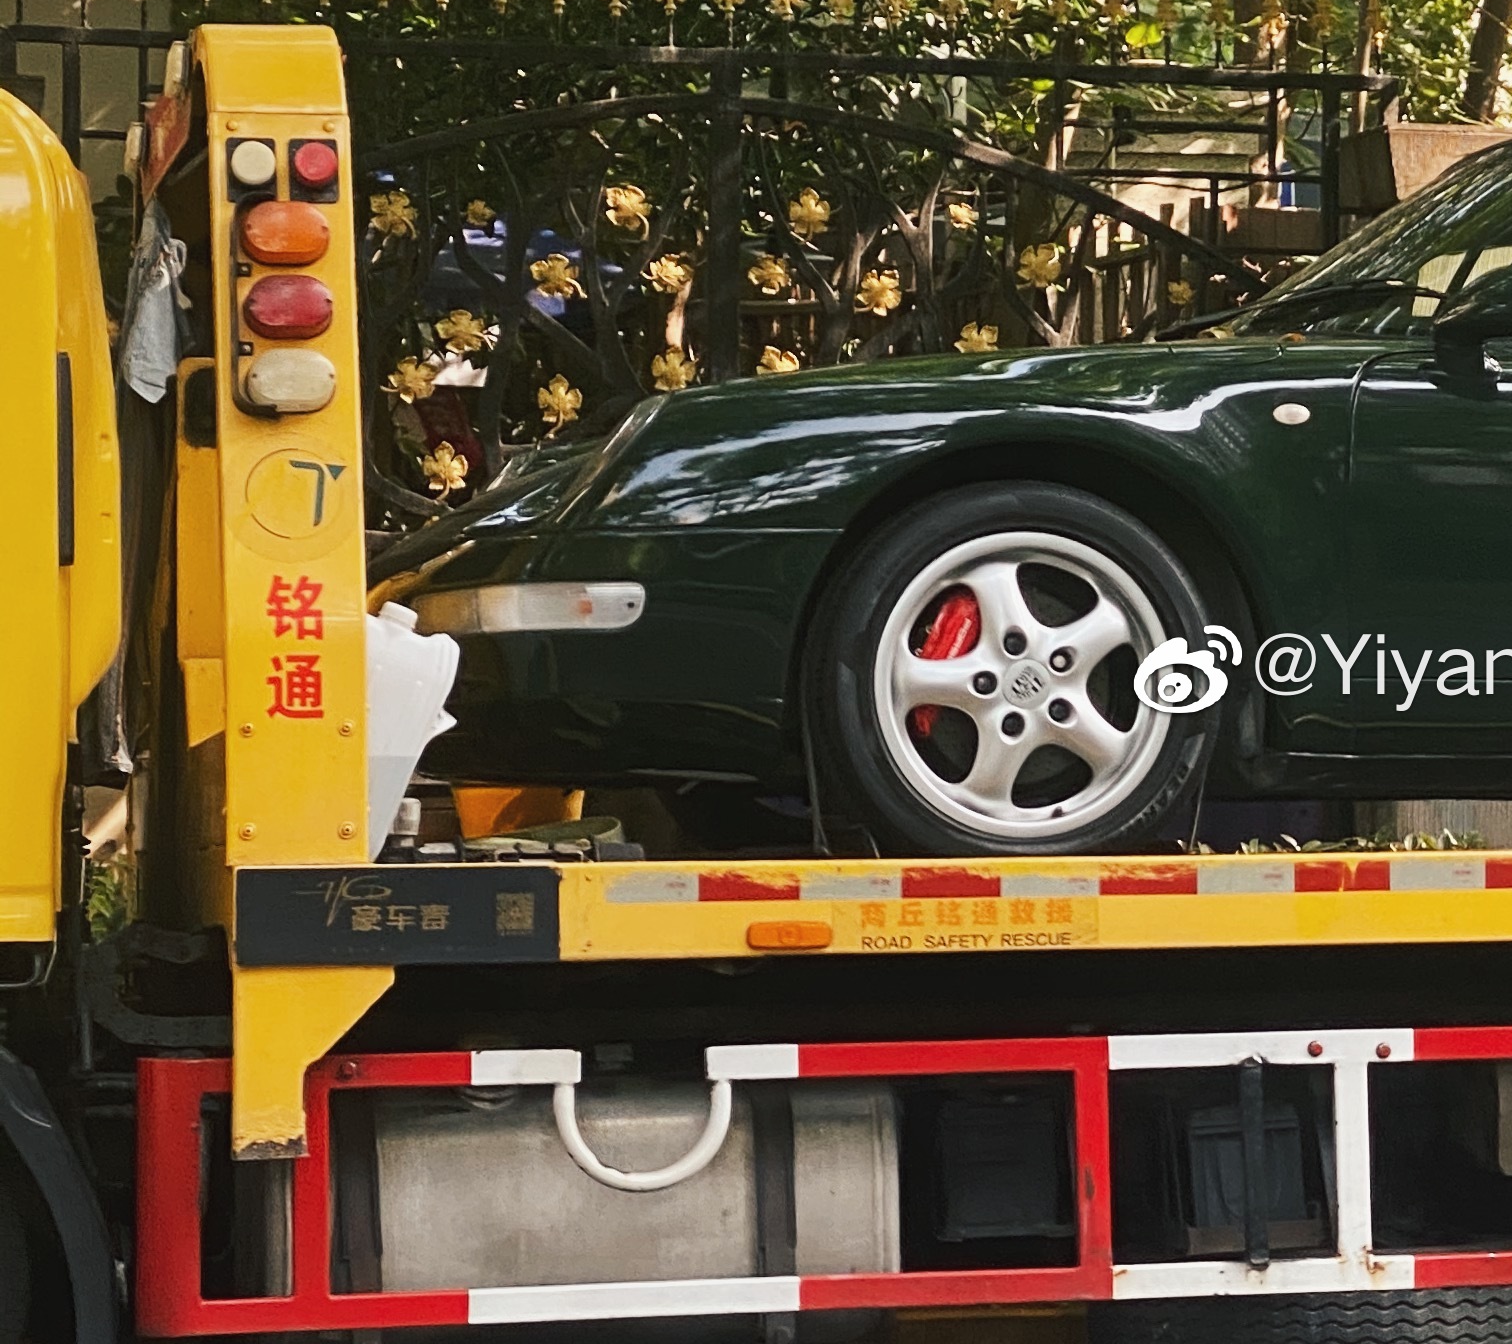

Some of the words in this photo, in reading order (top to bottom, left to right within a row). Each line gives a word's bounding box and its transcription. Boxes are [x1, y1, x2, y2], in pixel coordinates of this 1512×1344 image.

[267, 575, 324, 719] 铭通
[862, 936, 912, 949] ROAD
[924, 933, 993, 949] SAFETY
[1001, 932, 1072, 947] RESCUE
